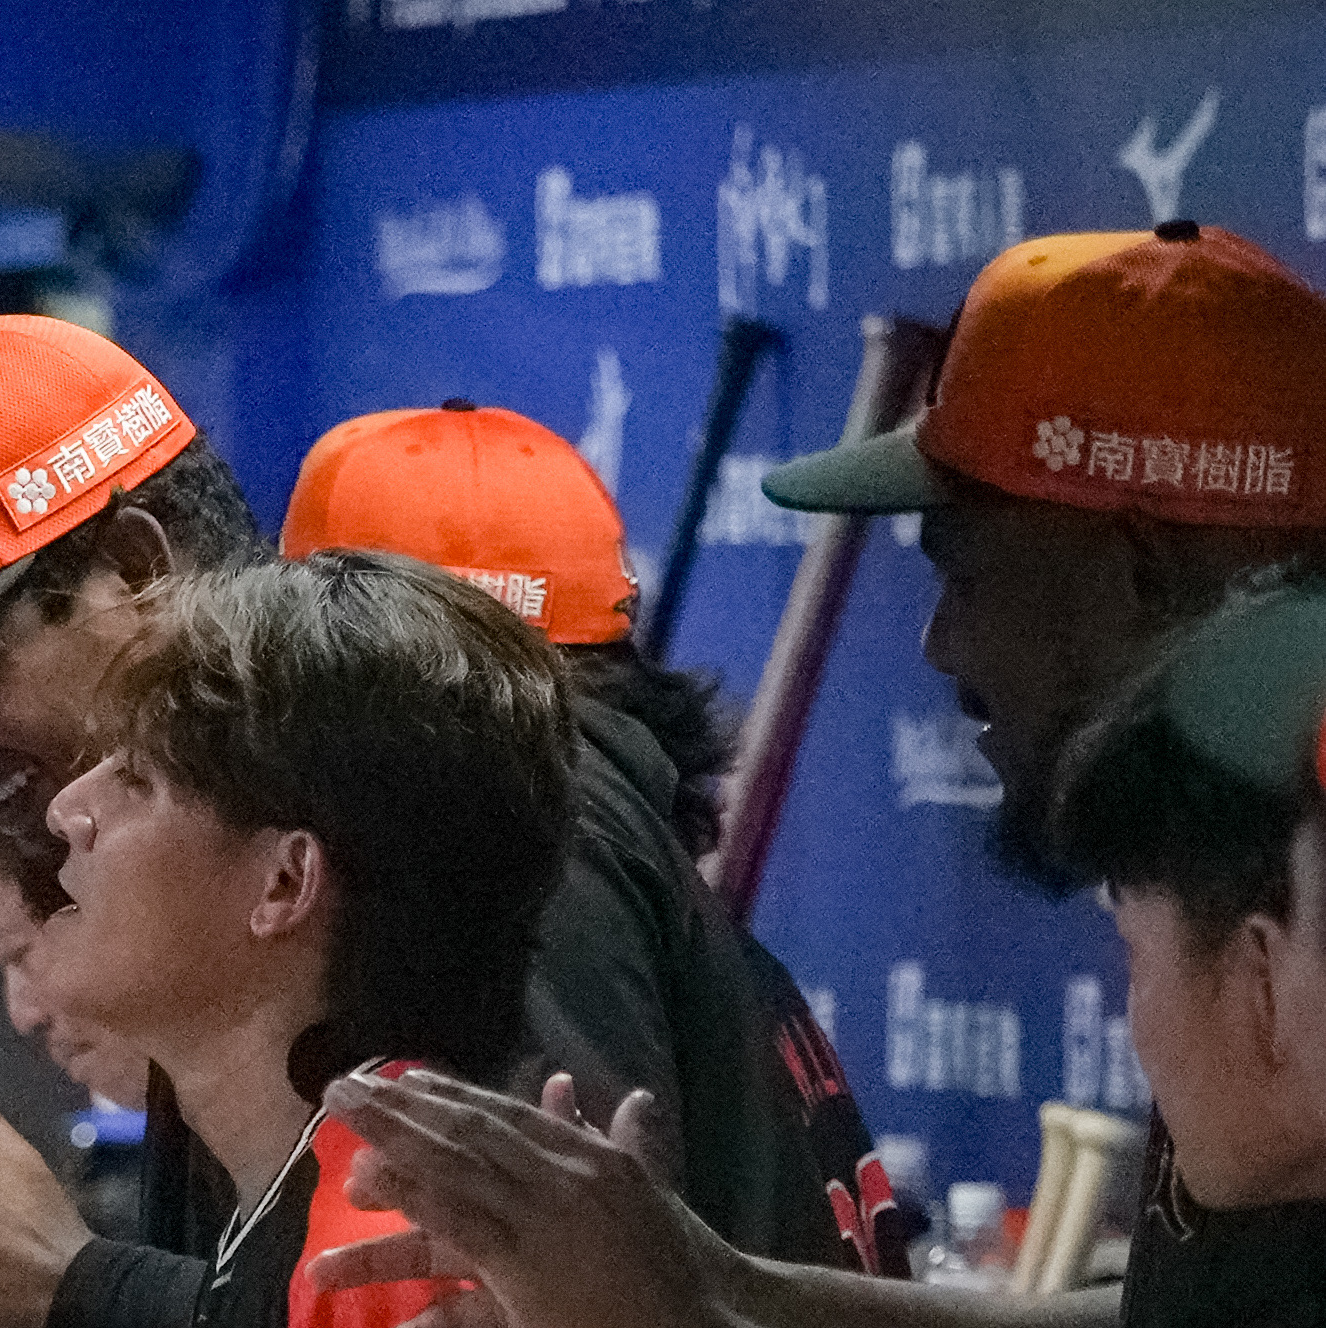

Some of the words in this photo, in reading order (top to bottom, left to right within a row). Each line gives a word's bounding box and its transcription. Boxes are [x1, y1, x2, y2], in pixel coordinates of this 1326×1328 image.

[47, 385, 173, 494] 南寶樹脂
[1088, 431, 1295, 495] 南寶樹脂
